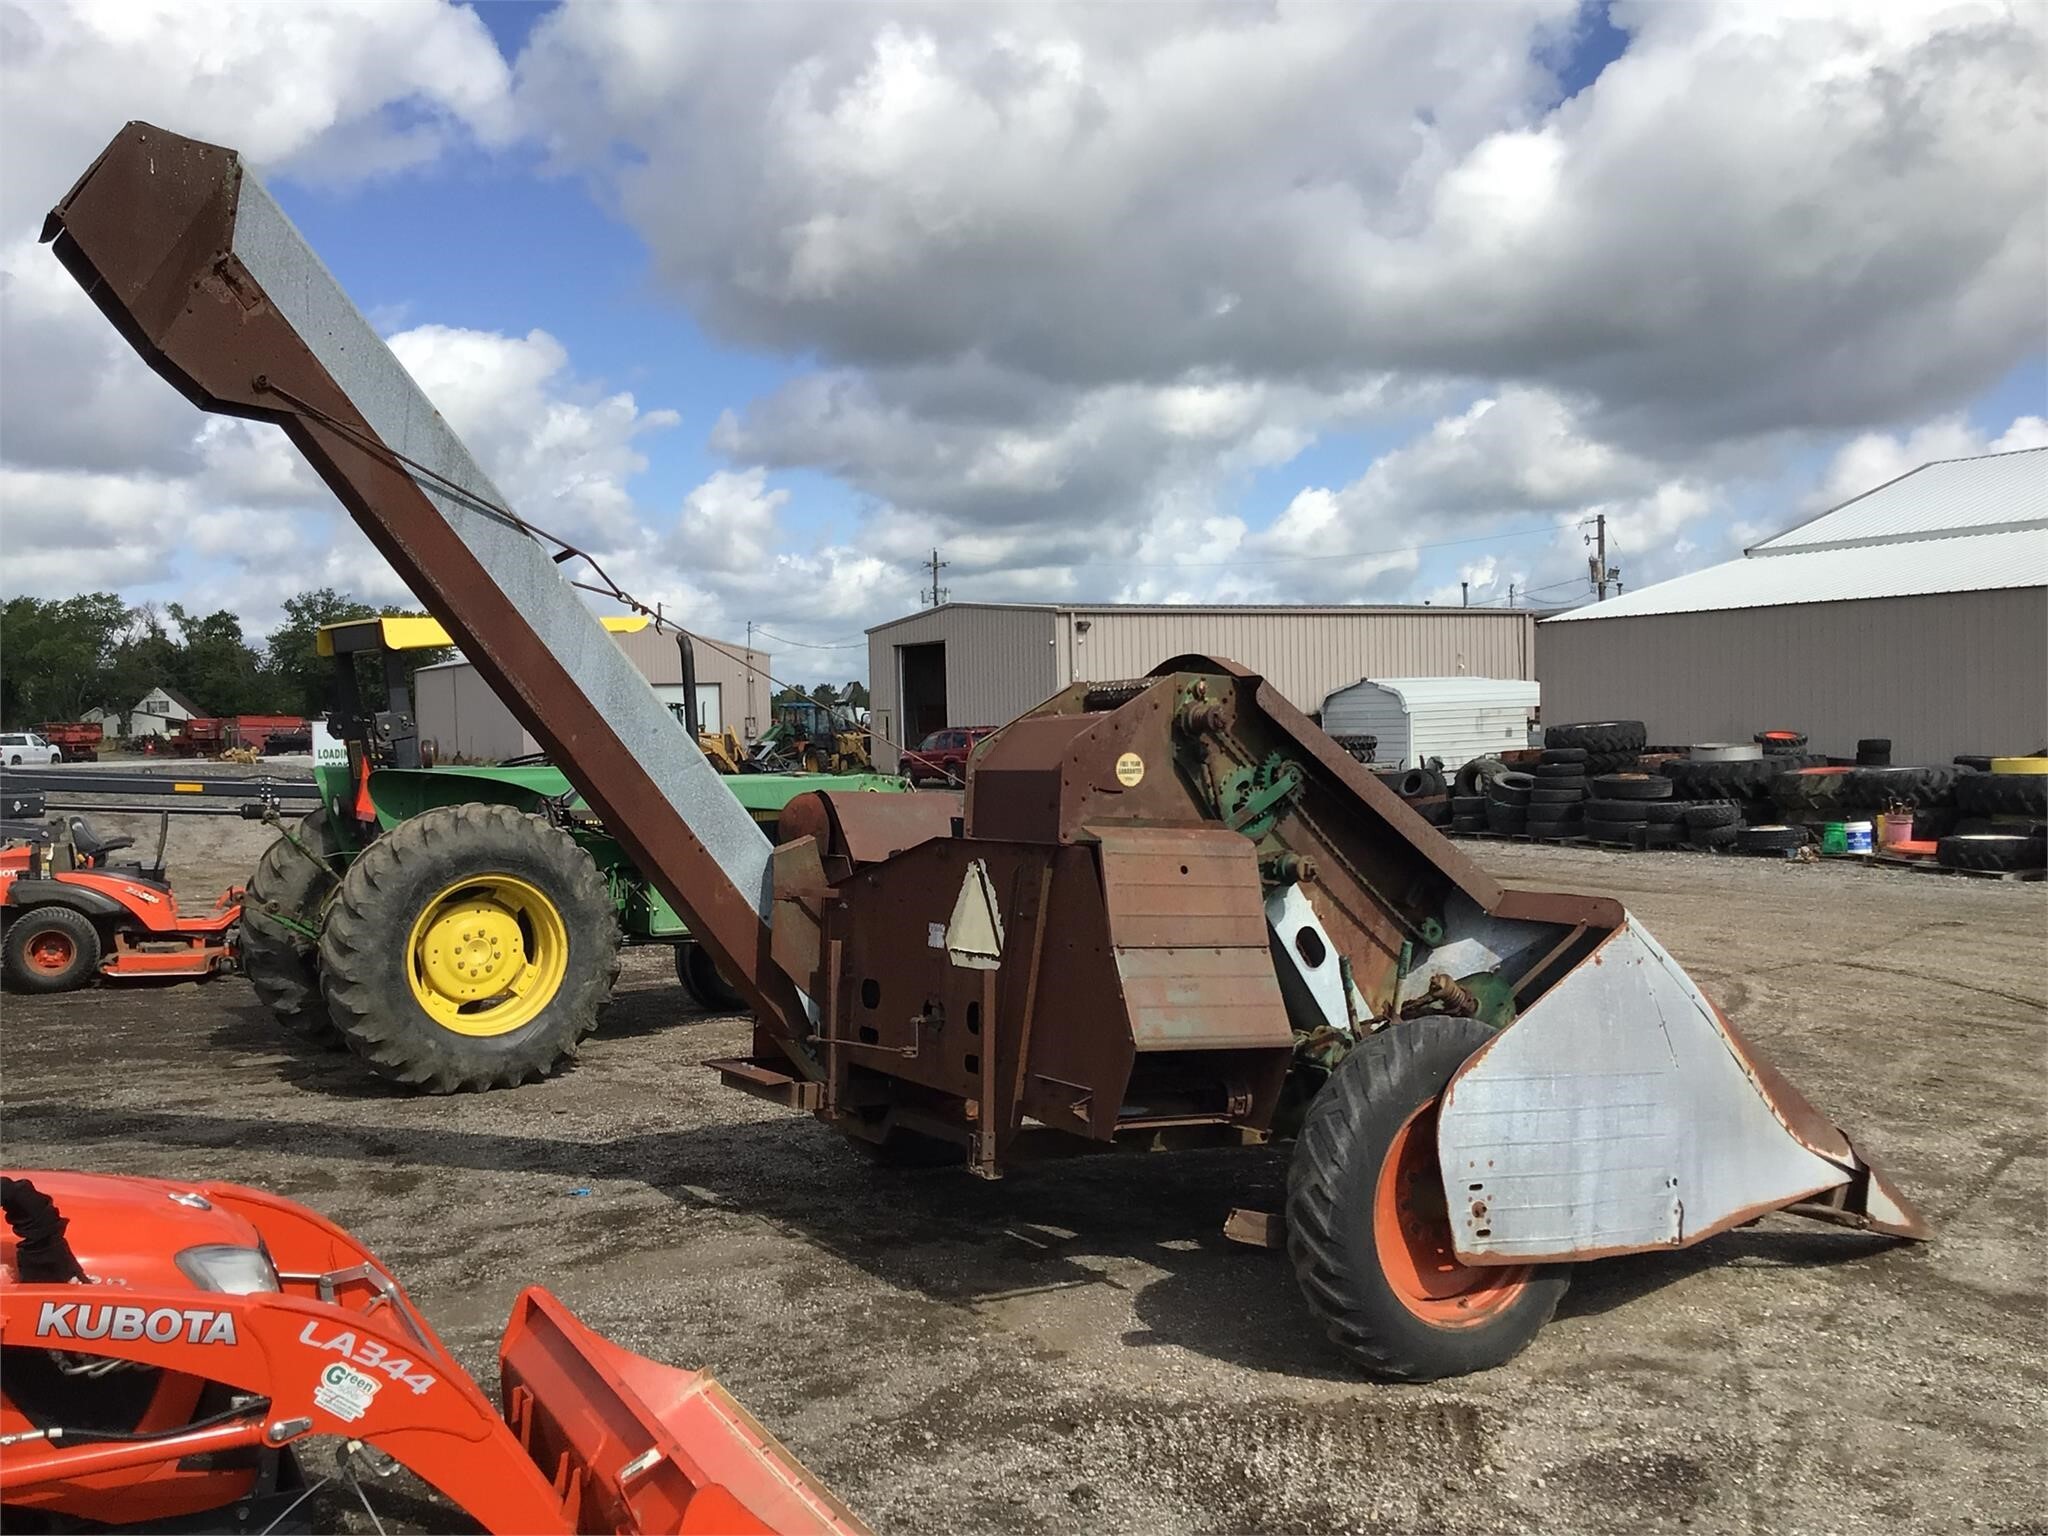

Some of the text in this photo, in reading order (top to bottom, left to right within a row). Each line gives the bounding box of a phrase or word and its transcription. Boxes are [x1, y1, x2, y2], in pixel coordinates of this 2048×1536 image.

[318, 749, 347, 759] LOADIN
[36, 1302, 237, 1345] KUBOTA
[299, 1321, 437, 1395] LA344
[326, 1365, 373, 1393] Green
